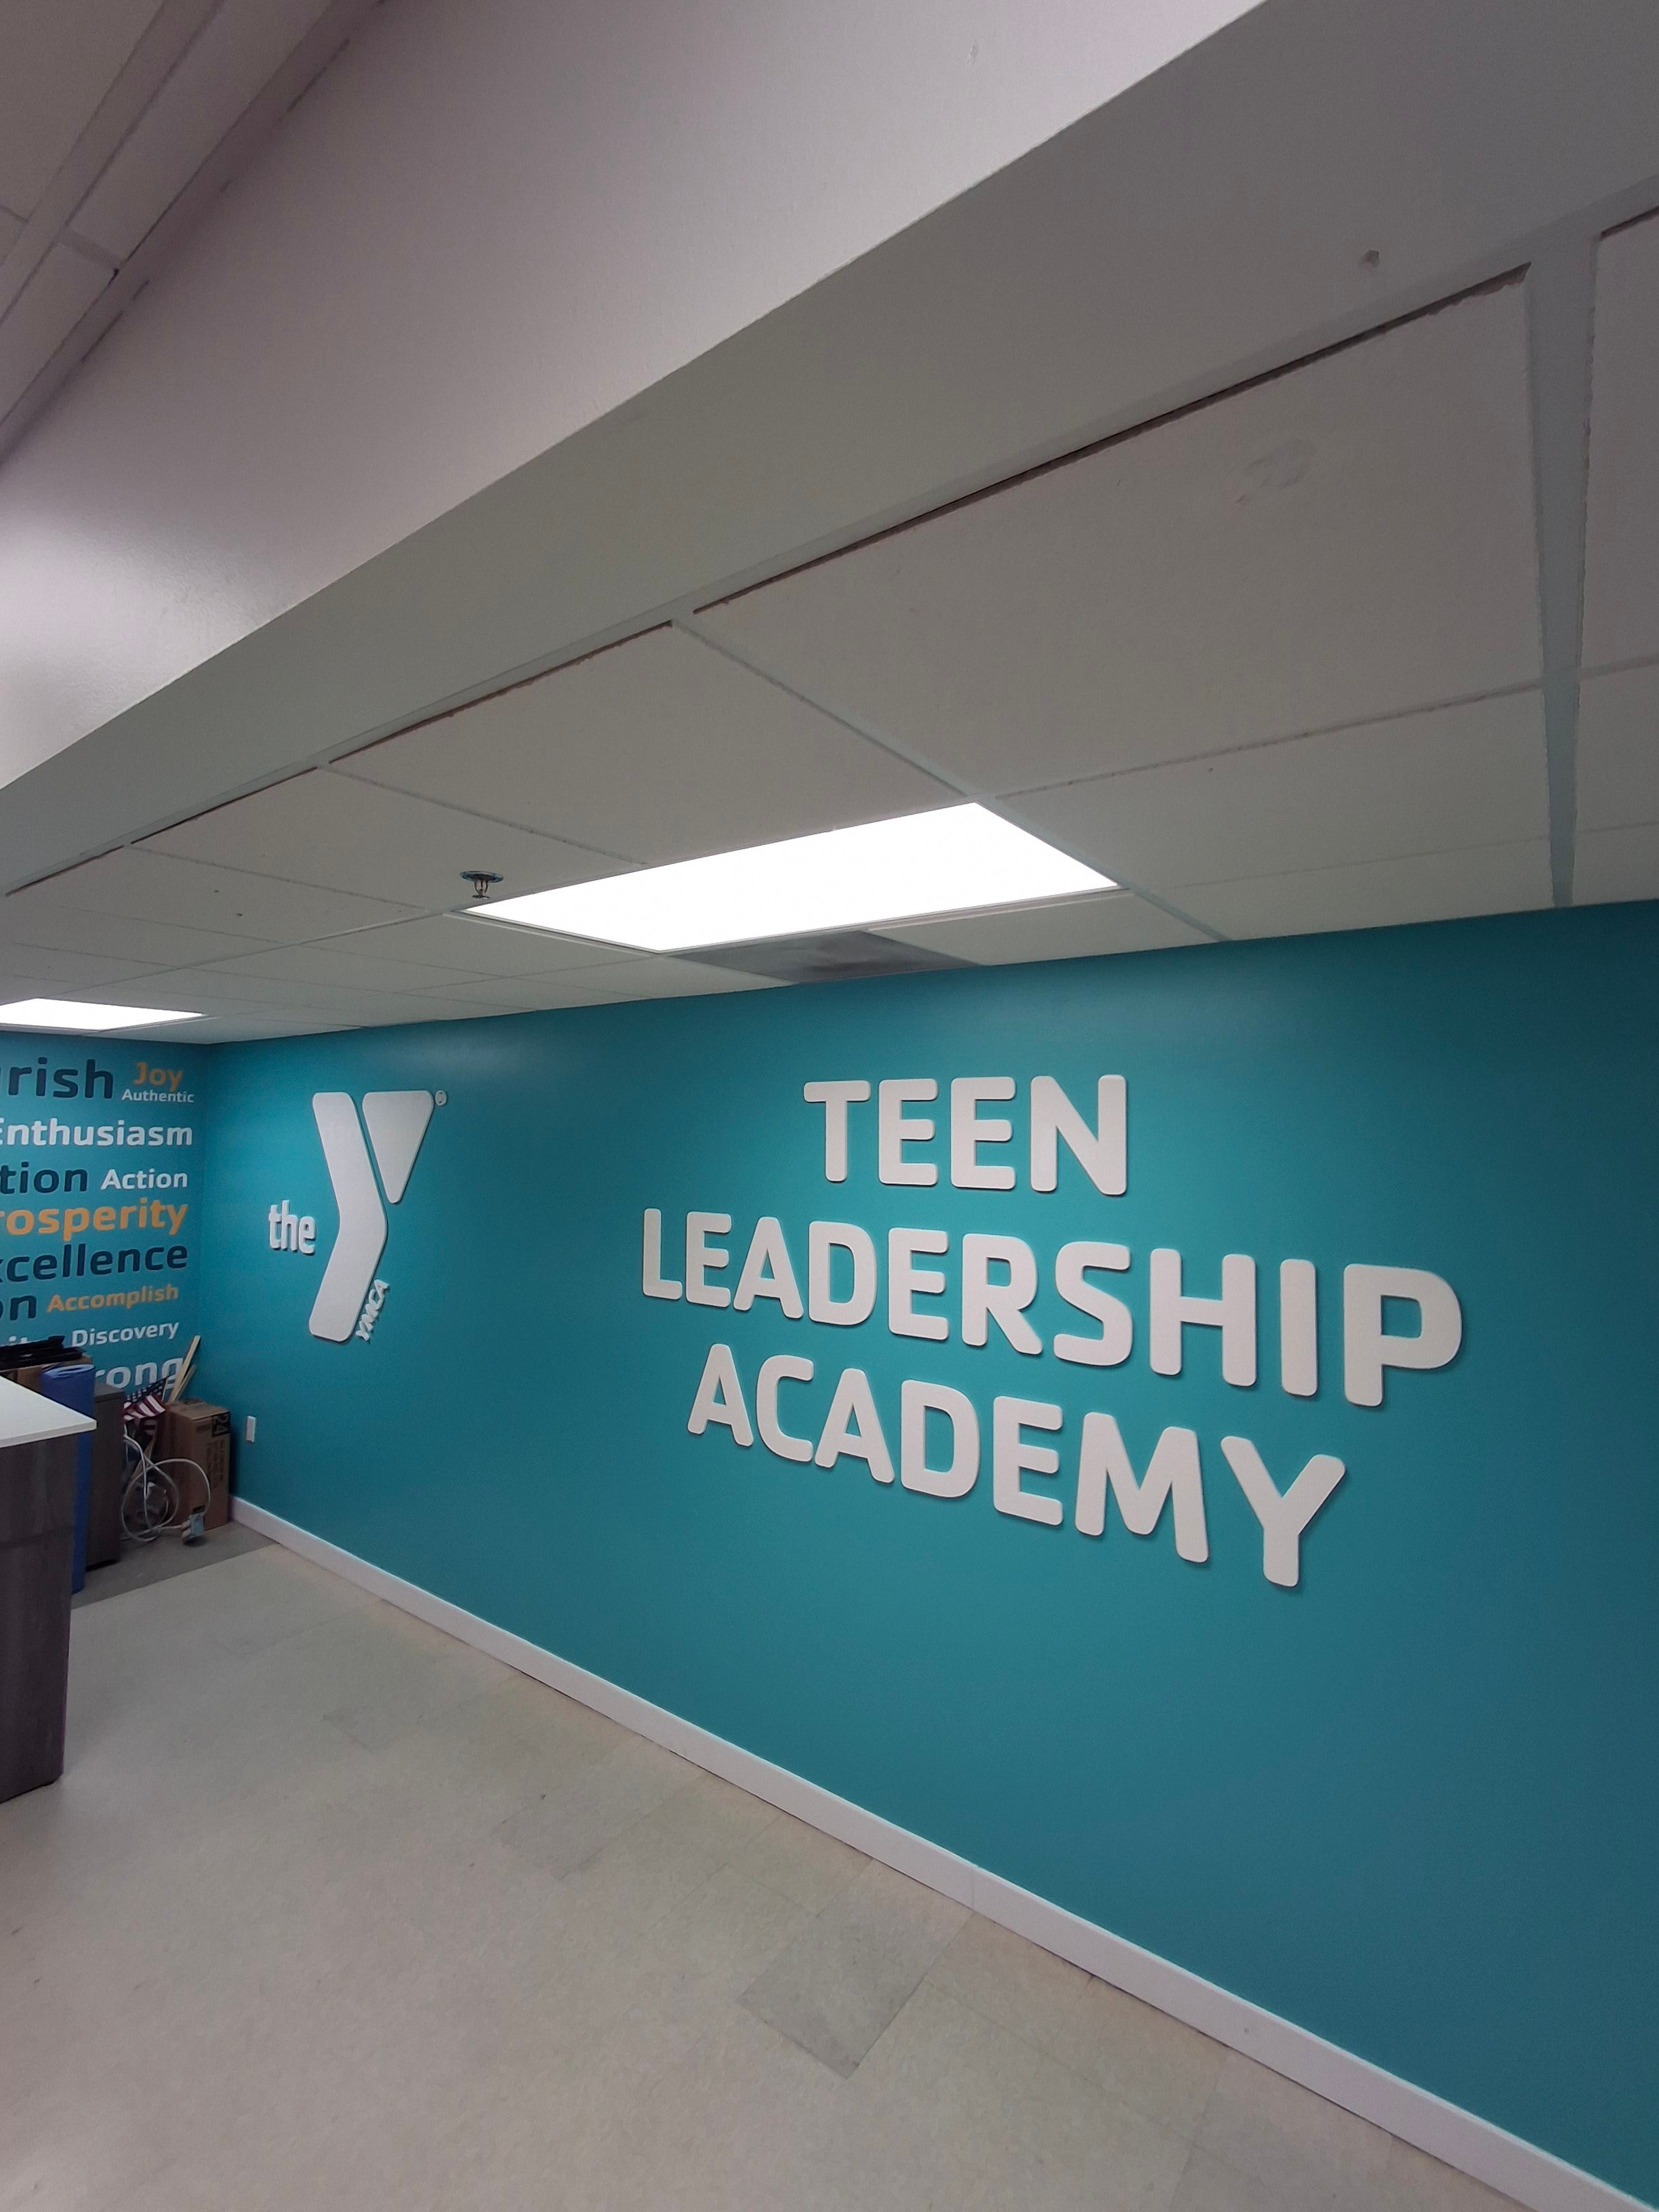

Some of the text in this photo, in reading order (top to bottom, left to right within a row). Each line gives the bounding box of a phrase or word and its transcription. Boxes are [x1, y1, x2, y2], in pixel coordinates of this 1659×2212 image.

[0, 1057, 183, 1099] rish Joy
[121, 1088, 194, 1103] Authentic
[804, 1075, 1127, 1195] TEEN
[0, 1162, 188, 1194] tion Action
[268, 1200, 316, 1254] the
[0, 1243, 188, 1282] cellence
[0, 1284, 179, 1321] n Accomplish
[355, 1279, 390, 1342] YMCA
[642, 1208, 1463, 1407] LEADERSHIP
[71, 1322, 180, 1347] Discovery
[96, 1357, 184, 1389] ong
[687, 1343, 1347, 1588] ACADEMY
